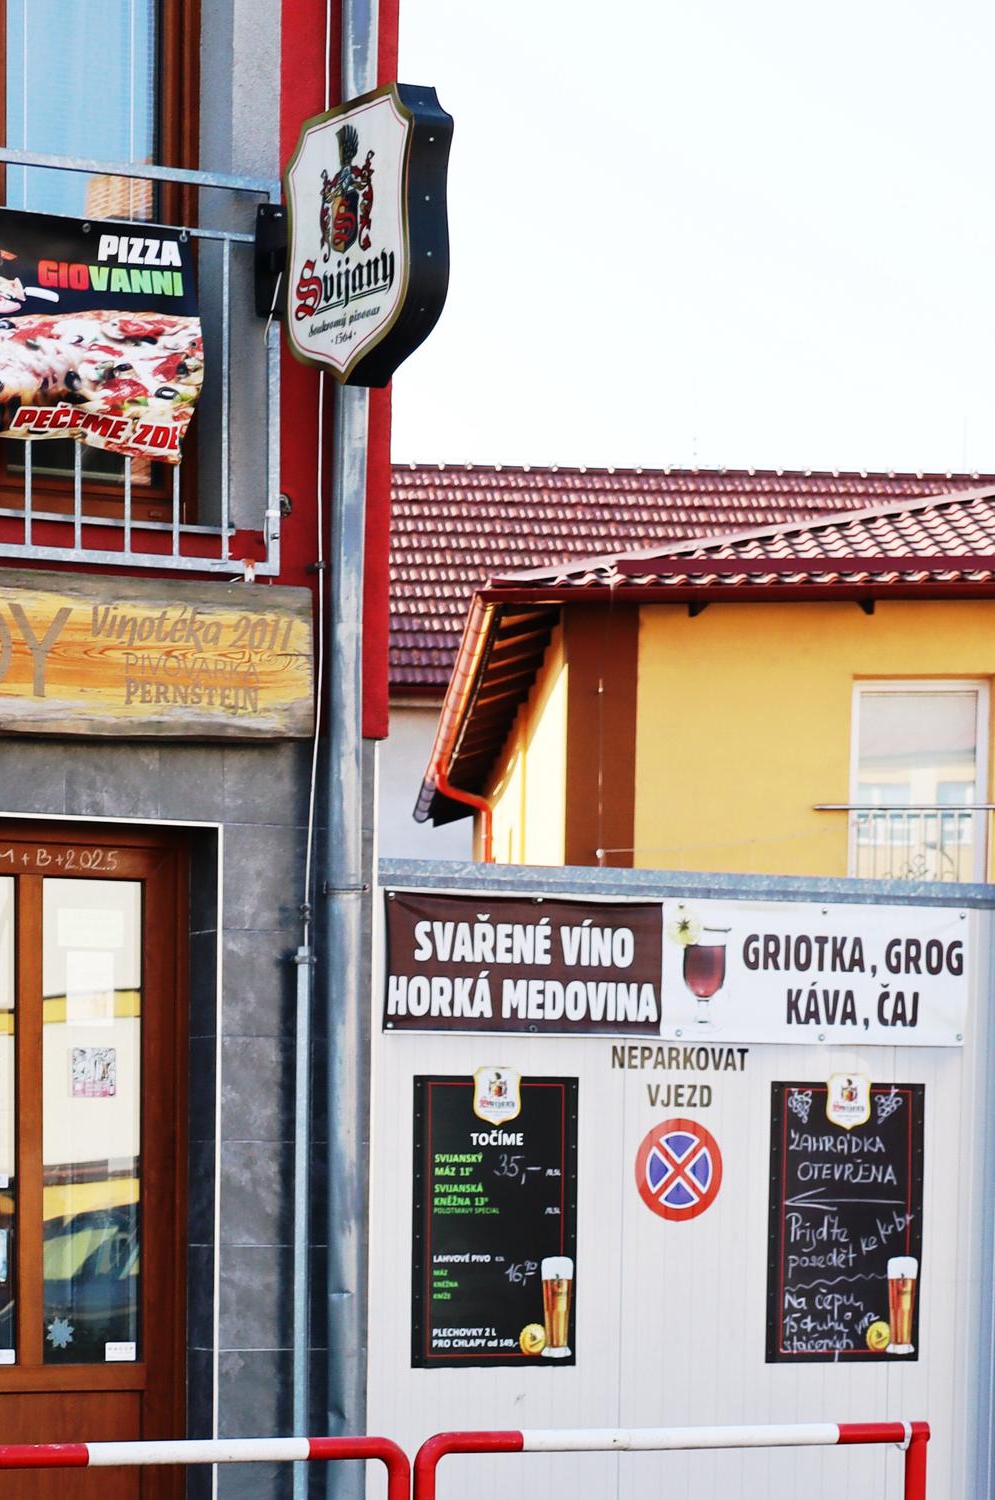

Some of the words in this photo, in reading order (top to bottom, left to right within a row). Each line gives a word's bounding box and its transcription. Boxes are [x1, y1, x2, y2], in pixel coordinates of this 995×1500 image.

[97, 234, 182, 267] PIZZA
[37, 259, 184, 297] GIOVANNI
[294, 248, 396, 321] Svijany
[11, 403, 130, 441] PEČEME
[91, 605, 222, 653] Vinotéka
[228, 615, 295, 652] 2011
[124, 652, 262, 685] PIVOVARKA
[124, 677, 260, 715] PERNŠTEJN
[414, 913, 552, 967] SVAŘENÉ
[561, 917, 635, 970] VÍNO
[742, 933, 877, 976] GRIOTKA,
[885, 937, 965, 977] GROG
[387, 970, 493, 1019] HORKÁ
[502, 978, 658, 1024] MEDOVINA
[786, 981, 870, 1031] KÁVA,
[877, 983, 921, 1028] ČAJ
[611, 1045, 749, 1071] NEPARKOVAT
[647, 1084, 713, 1108] VJEZD
[470, 1130, 524, 1146] TOČÍME
[788, 1129, 886, 1155] ZAHRÁDKA
[434, 1165, 456, 1176] MÁZ
[797, 1159, 898, 1185] OTEVŘENA
[433, 1195, 471, 1206] KNĚŽNA
[433, 1253, 470, 1263] LAHVOVÉ
[471, 1254, 491, 1263] PIVO
[784, 1291, 808, 1310] Na
[432, 1327, 484, 1337] PLECHOVKY
[484, 1328, 491, 1337] 2
[432, 1339, 451, 1348] PRO
[452, 1339, 487, 1348] CHLAPY
